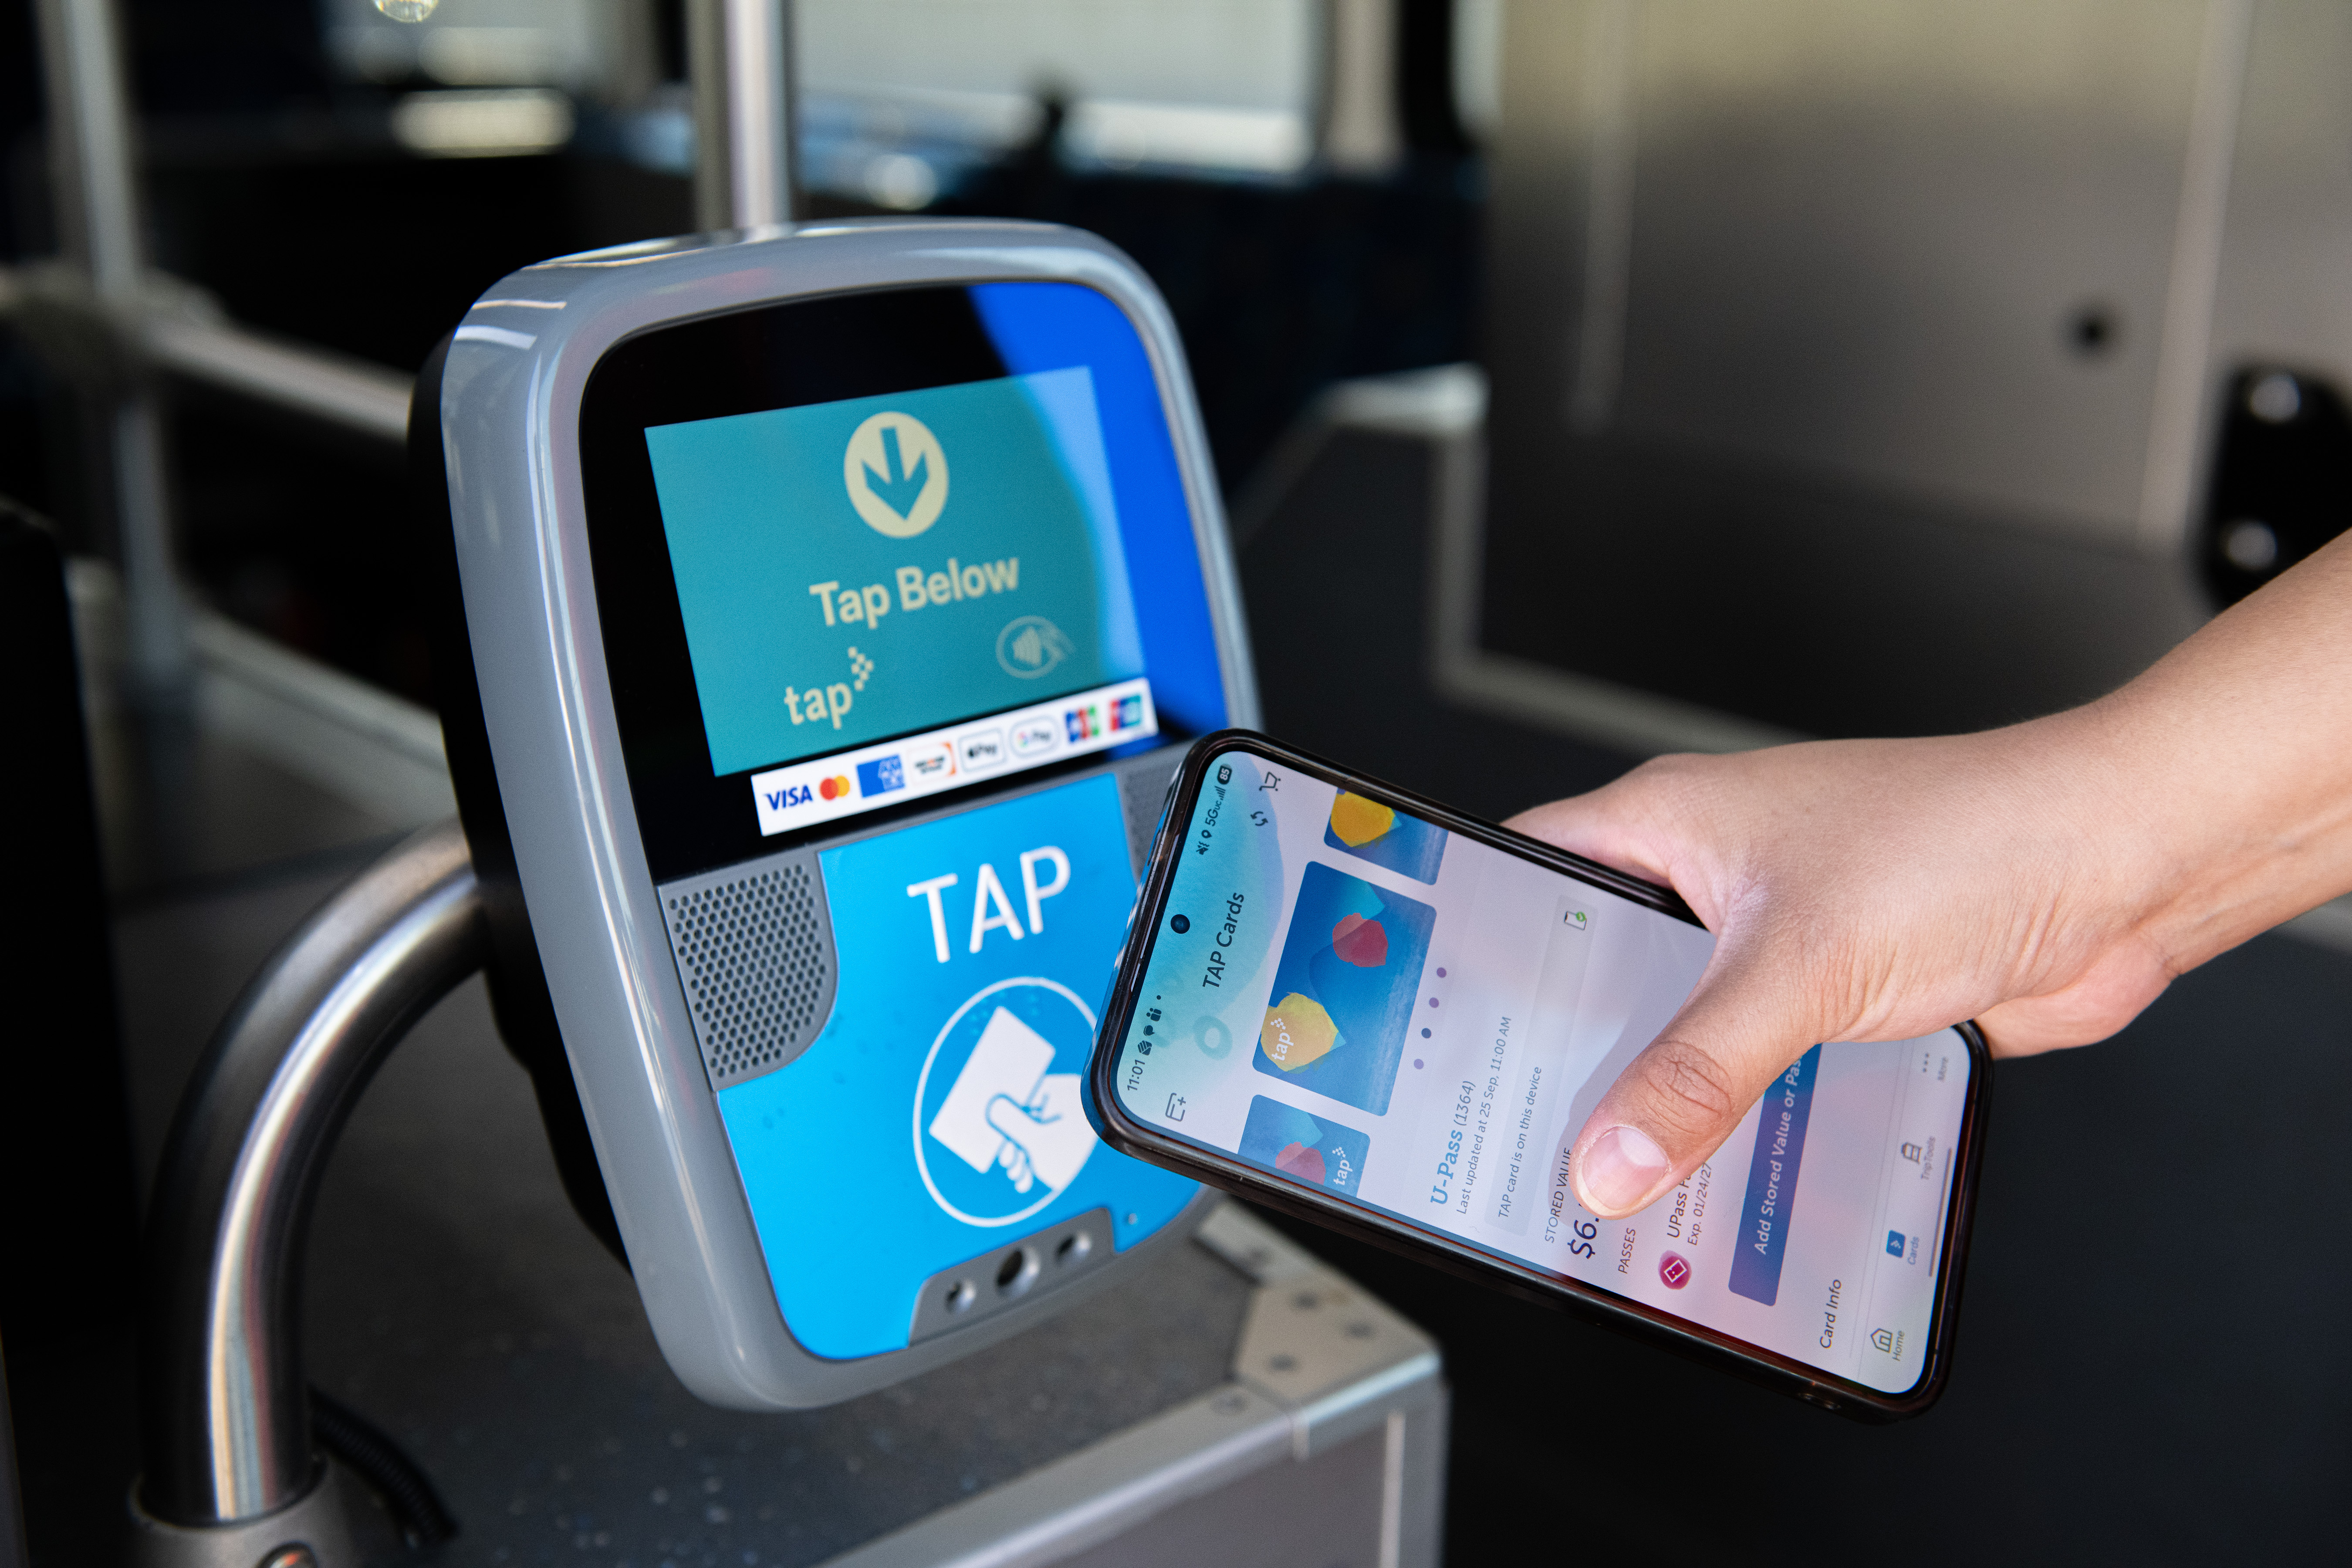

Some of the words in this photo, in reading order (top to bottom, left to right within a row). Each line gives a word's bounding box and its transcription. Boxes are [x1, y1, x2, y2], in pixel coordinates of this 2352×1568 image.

[809, 581, 890, 629] Tap
[896, 558, 1020, 612] Below
[784, 682, 852, 729] tap
[1220, 768, 1230, 781] 85
[764, 784, 813, 811] VISA
[906, 845, 1071, 963] TAP
[1202, 950, 1226, 988] TAP
[1216, 892, 1245, 947] Cards
[1499, 1017, 1512, 1036] AM
[1271, 1031, 1294, 1061] tap
[1490, 1038, 1507, 1071] 11:00
[1127, 1060, 1146, 1091] 11:01
[1484, 1075, 1500, 1099] Sep,
[1527, 1067, 1541, 1105] device
[1480, 1102, 1491, 1118] 25
[1784, 1088, 1796, 1107] or
[1480, 1120, 1487, 1133] at
[1520, 1108, 1532, 1131] this
[1772, 1110, 1791, 1157] Value
[1430, 1130, 1463, 1205] U-Pass
[1453, 1081, 1476, 1126] (1364)
[1511, 1152, 1522, 1161] is
[1517, 1133, 1527, 1149] on
[1333, 1159, 1353, 1186] tap
[1467, 1134, 1484, 1186] updated
[1507, 1161, 1520, 1193] card
[1693, 1163, 1712, 1217] 01/24/27
[1761, 1160, 1783, 1217] Stored
[1456, 1188, 1471, 1215] Last
[1498, 1193, 1512, 1218] TAP
[1545, 1191, 1564, 1243] STORED
[1666, 1191, 1688, 1238] UPass
[1567, 1204, 1599, 1259] $6.
[1687, 1222, 1702, 1246] Exp.
[1755, 1220, 1772, 1255] Add
[1618, 1228, 1636, 1274] PASSES
[1907, 1236, 1920, 1265] Cards
[1826, 1279, 1842, 1309] Info
[1820, 1312, 1836, 1350] Card
[1892, 1329, 1906, 1362] Home
